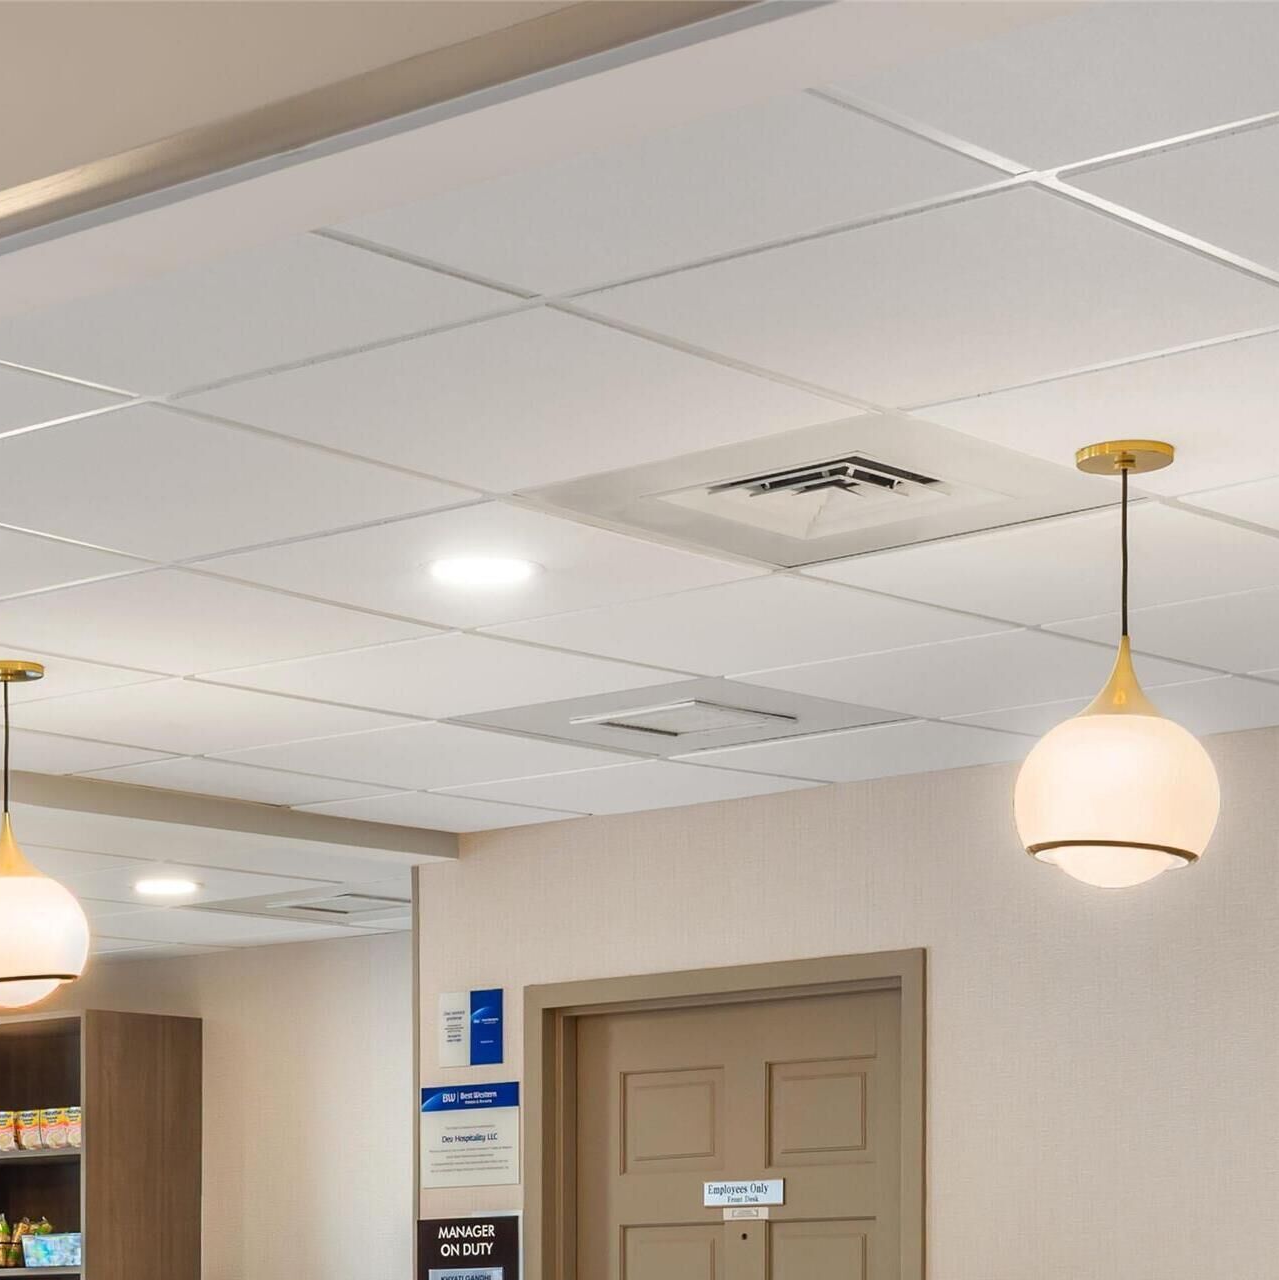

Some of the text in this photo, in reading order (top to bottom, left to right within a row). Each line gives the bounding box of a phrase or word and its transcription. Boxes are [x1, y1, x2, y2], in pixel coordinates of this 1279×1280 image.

[455, 1133, 486, 1143] Hospitality
[708, 1183, 769, 1195] Employees Only
[438, 1225, 495, 1239] MANAGER
[441, 1242, 493, 1257] ON DUTY
